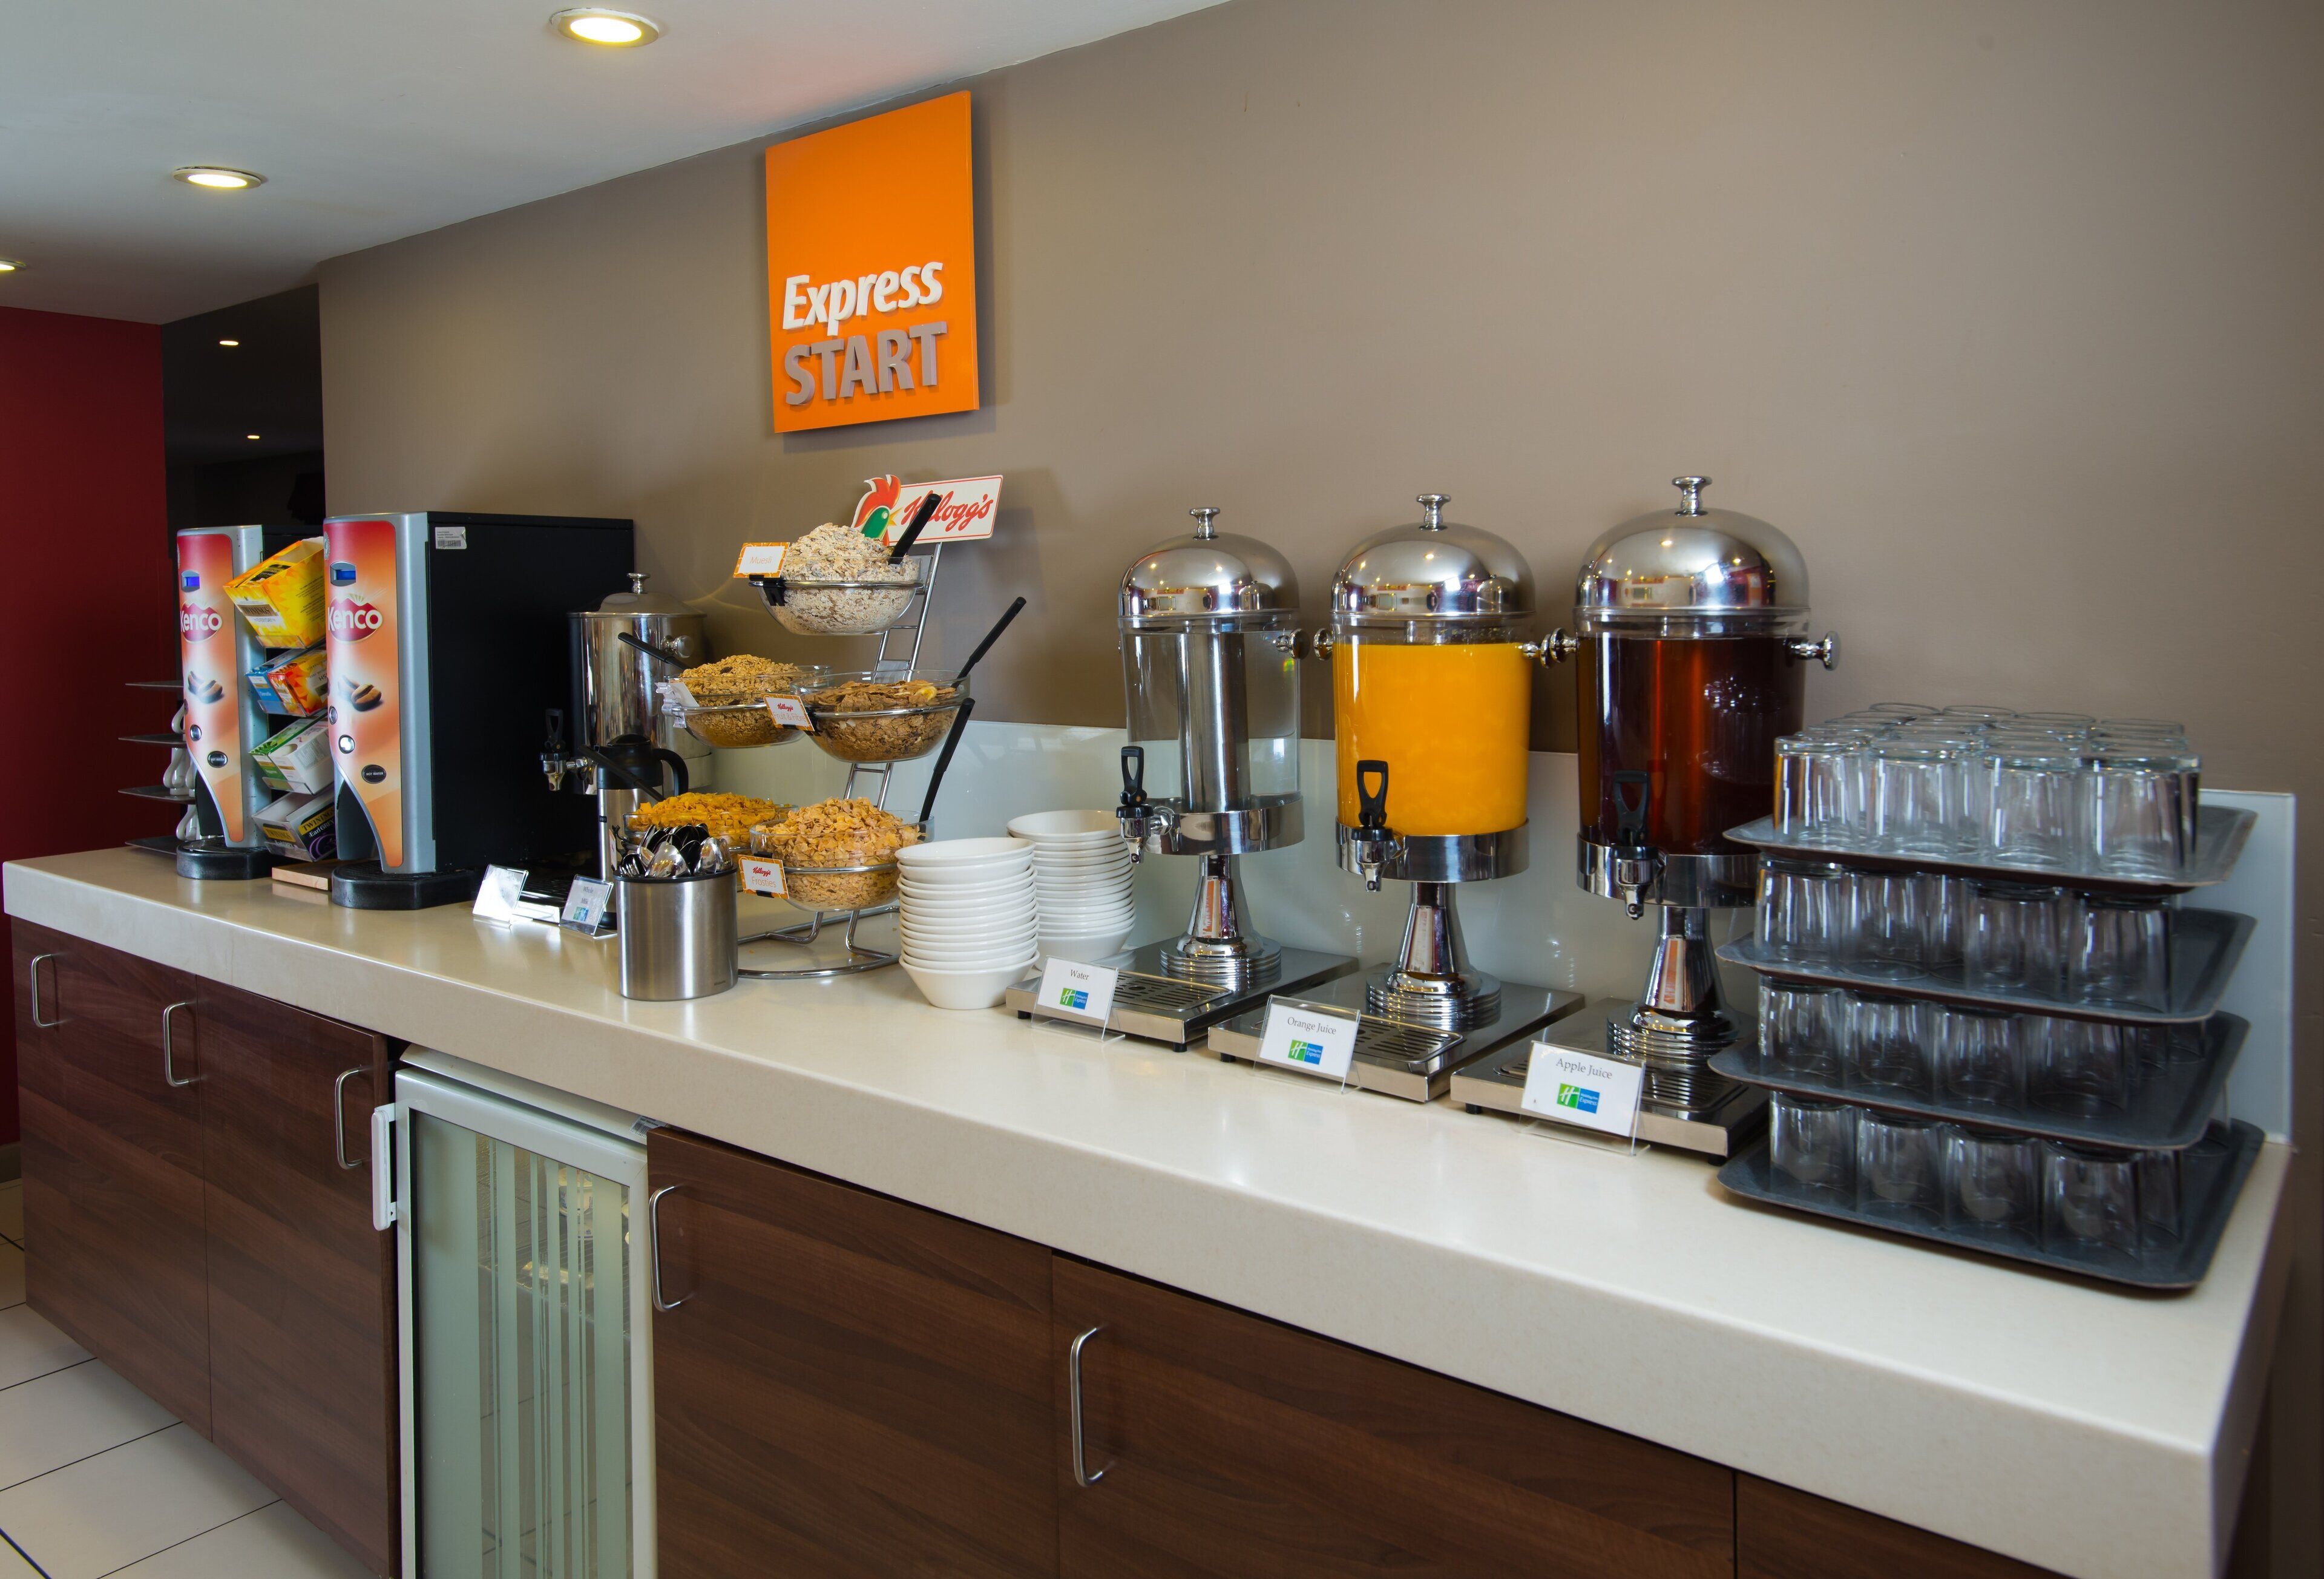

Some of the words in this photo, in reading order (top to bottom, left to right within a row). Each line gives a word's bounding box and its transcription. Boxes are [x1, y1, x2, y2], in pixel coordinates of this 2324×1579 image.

[783, 261, 943, 336] Express
[784, 321, 947, 405] START
[180, 611, 222, 632] Kenco
[327, 606, 382, 631] Kenco
[309, 827, 321, 837] Earl
[753, 867, 771, 877] Kellogg's
[752, 876, 776, 888] Frosties
[1070, 969, 1089, 980] Water
[1287, 1017, 1316, 1032] Orange
[1316, 1022, 1336, 1034] Juice
[1555, 1058, 1586, 1073] Apple
[1587, 1065, 1612, 1079] Juice
